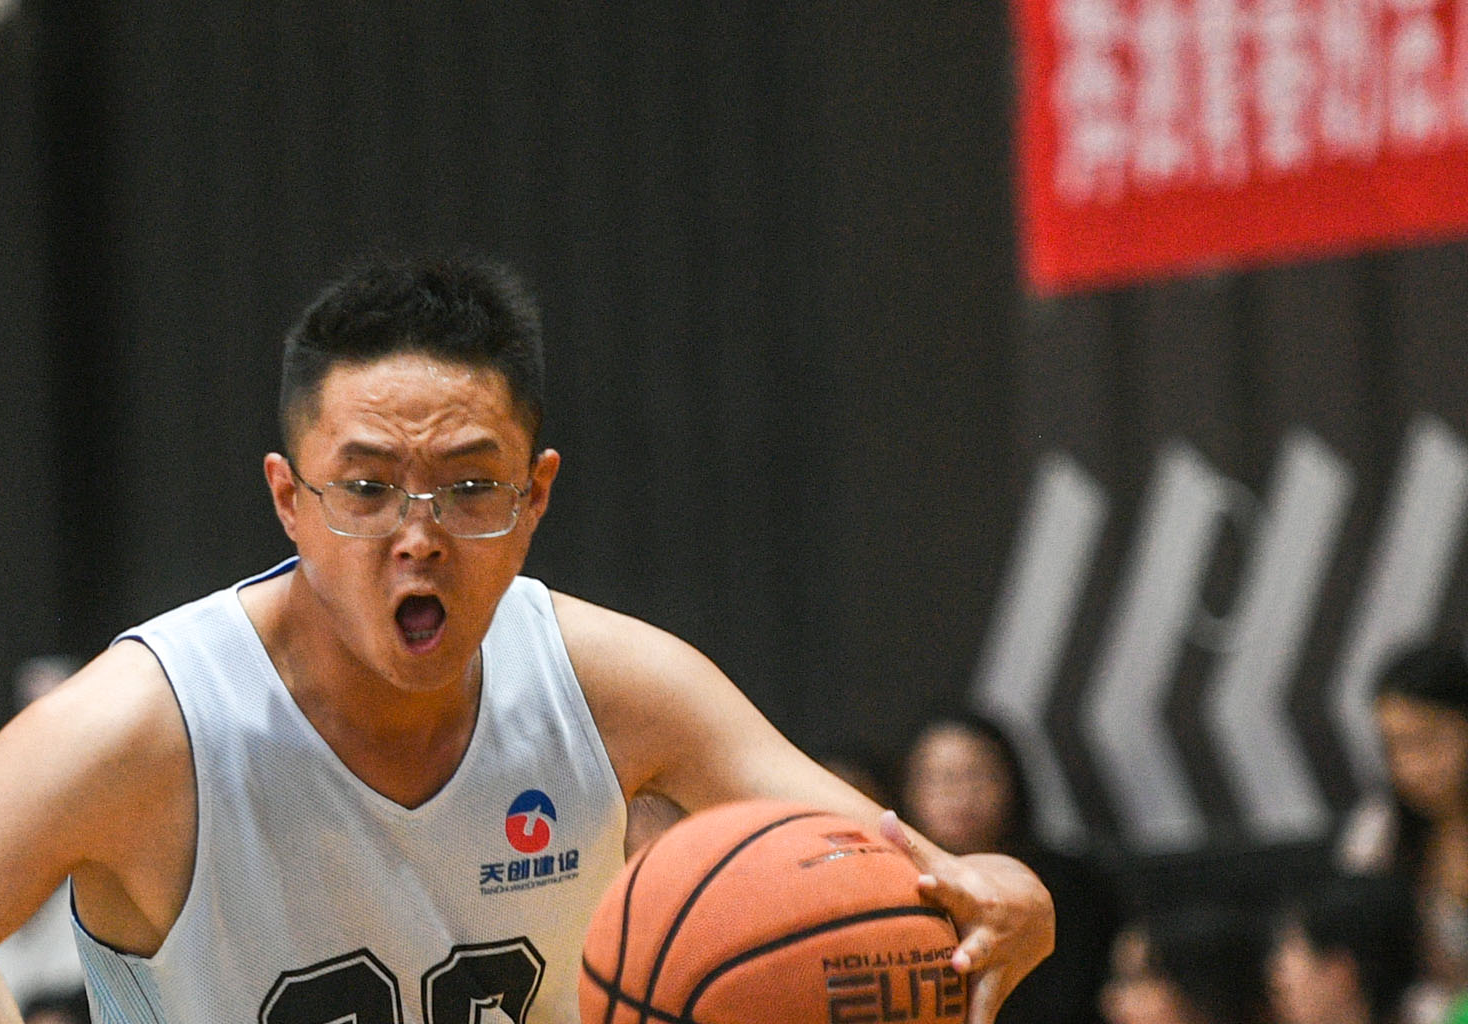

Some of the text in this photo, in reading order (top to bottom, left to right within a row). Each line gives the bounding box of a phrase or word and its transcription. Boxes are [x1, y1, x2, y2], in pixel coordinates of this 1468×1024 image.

[479, 850, 580, 885] 天创建设
[822, 945, 957, 973] OMPETITION
